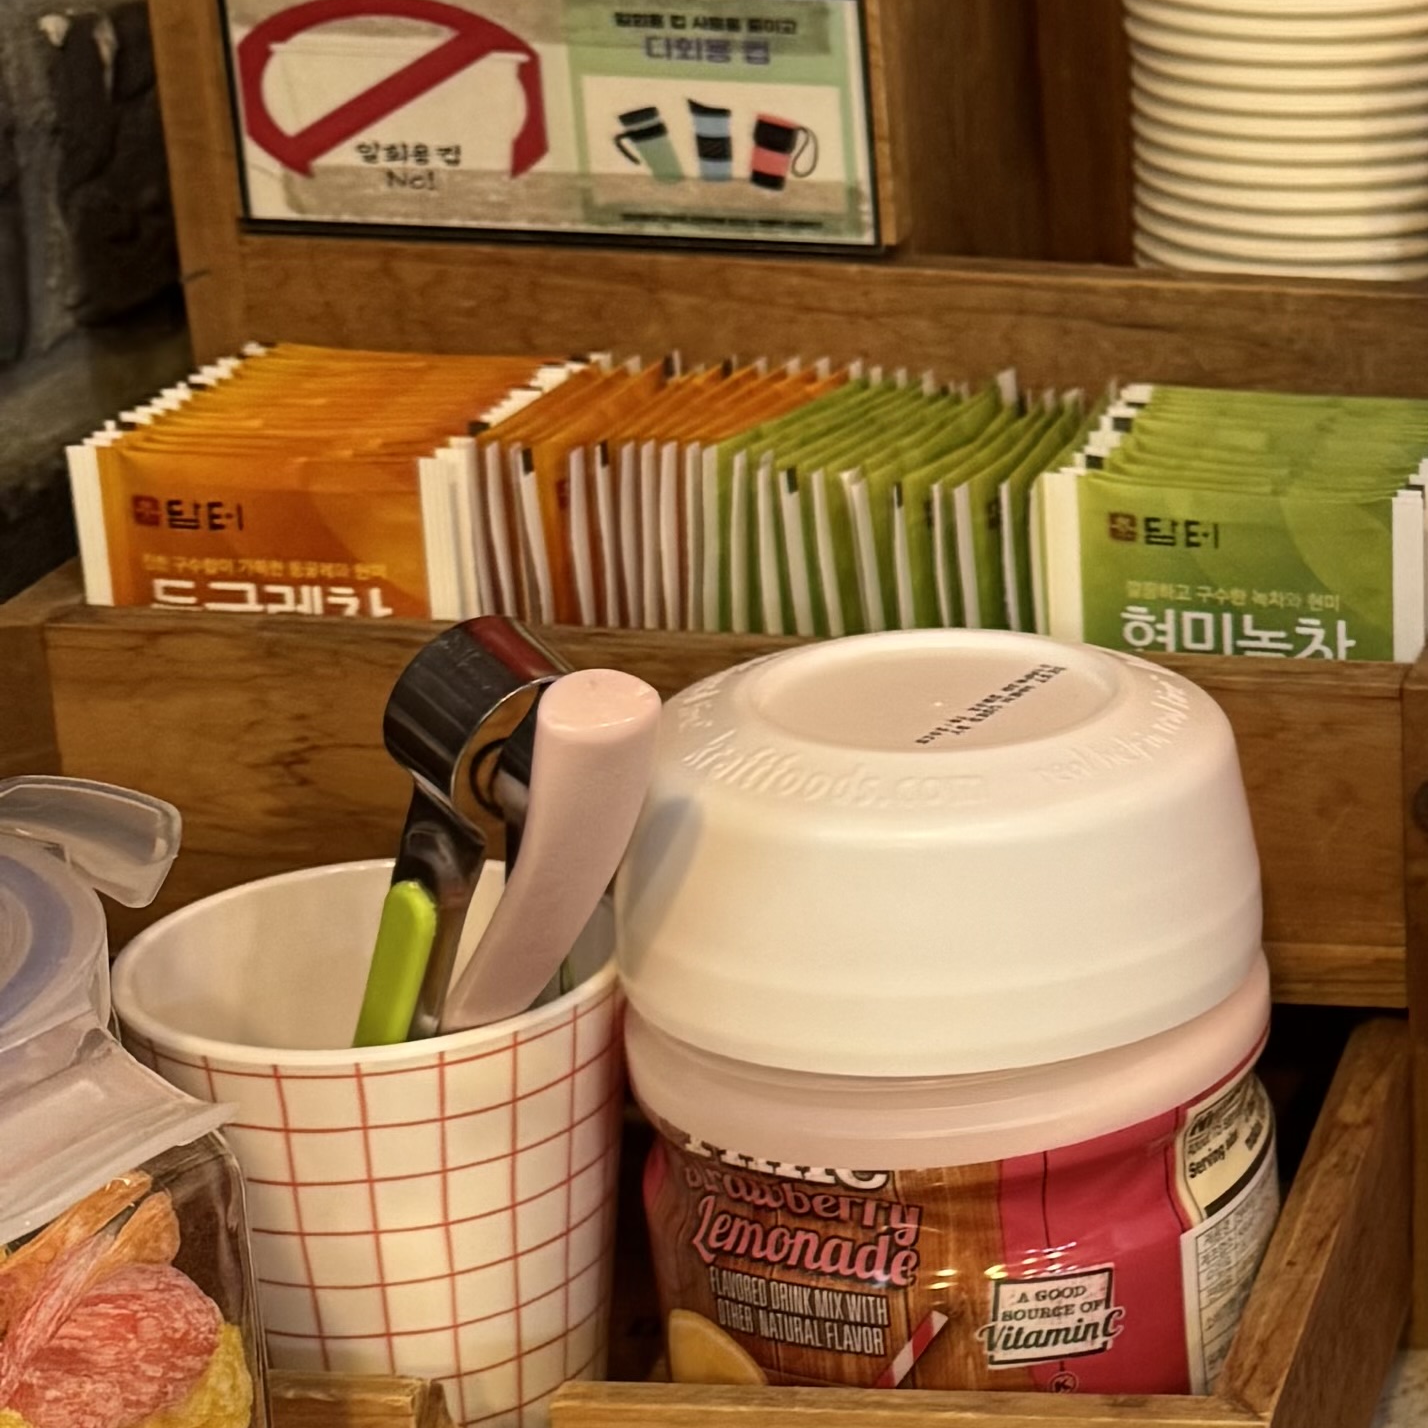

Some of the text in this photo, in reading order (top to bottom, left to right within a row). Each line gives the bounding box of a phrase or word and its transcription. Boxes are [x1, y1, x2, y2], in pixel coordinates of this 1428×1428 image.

[166, 499, 245, 532] 담터
[1144, 516, 1219, 549] 담터
[1307, 592, 1340, 613] 현미
[692, 1194, 920, 1287] Lemonade
[709, 1265, 889, 1326] FLAVORED DRINK MIX WITH
[1001, 1299, 1106, 1322] SOURCE OF
[1017, 1285, 1087, 1304] A GOOD
[716, 1297, 886, 1356] OTHER NATURAL FLAVOR
[978, 1309, 1124, 1352] Vitamin C
